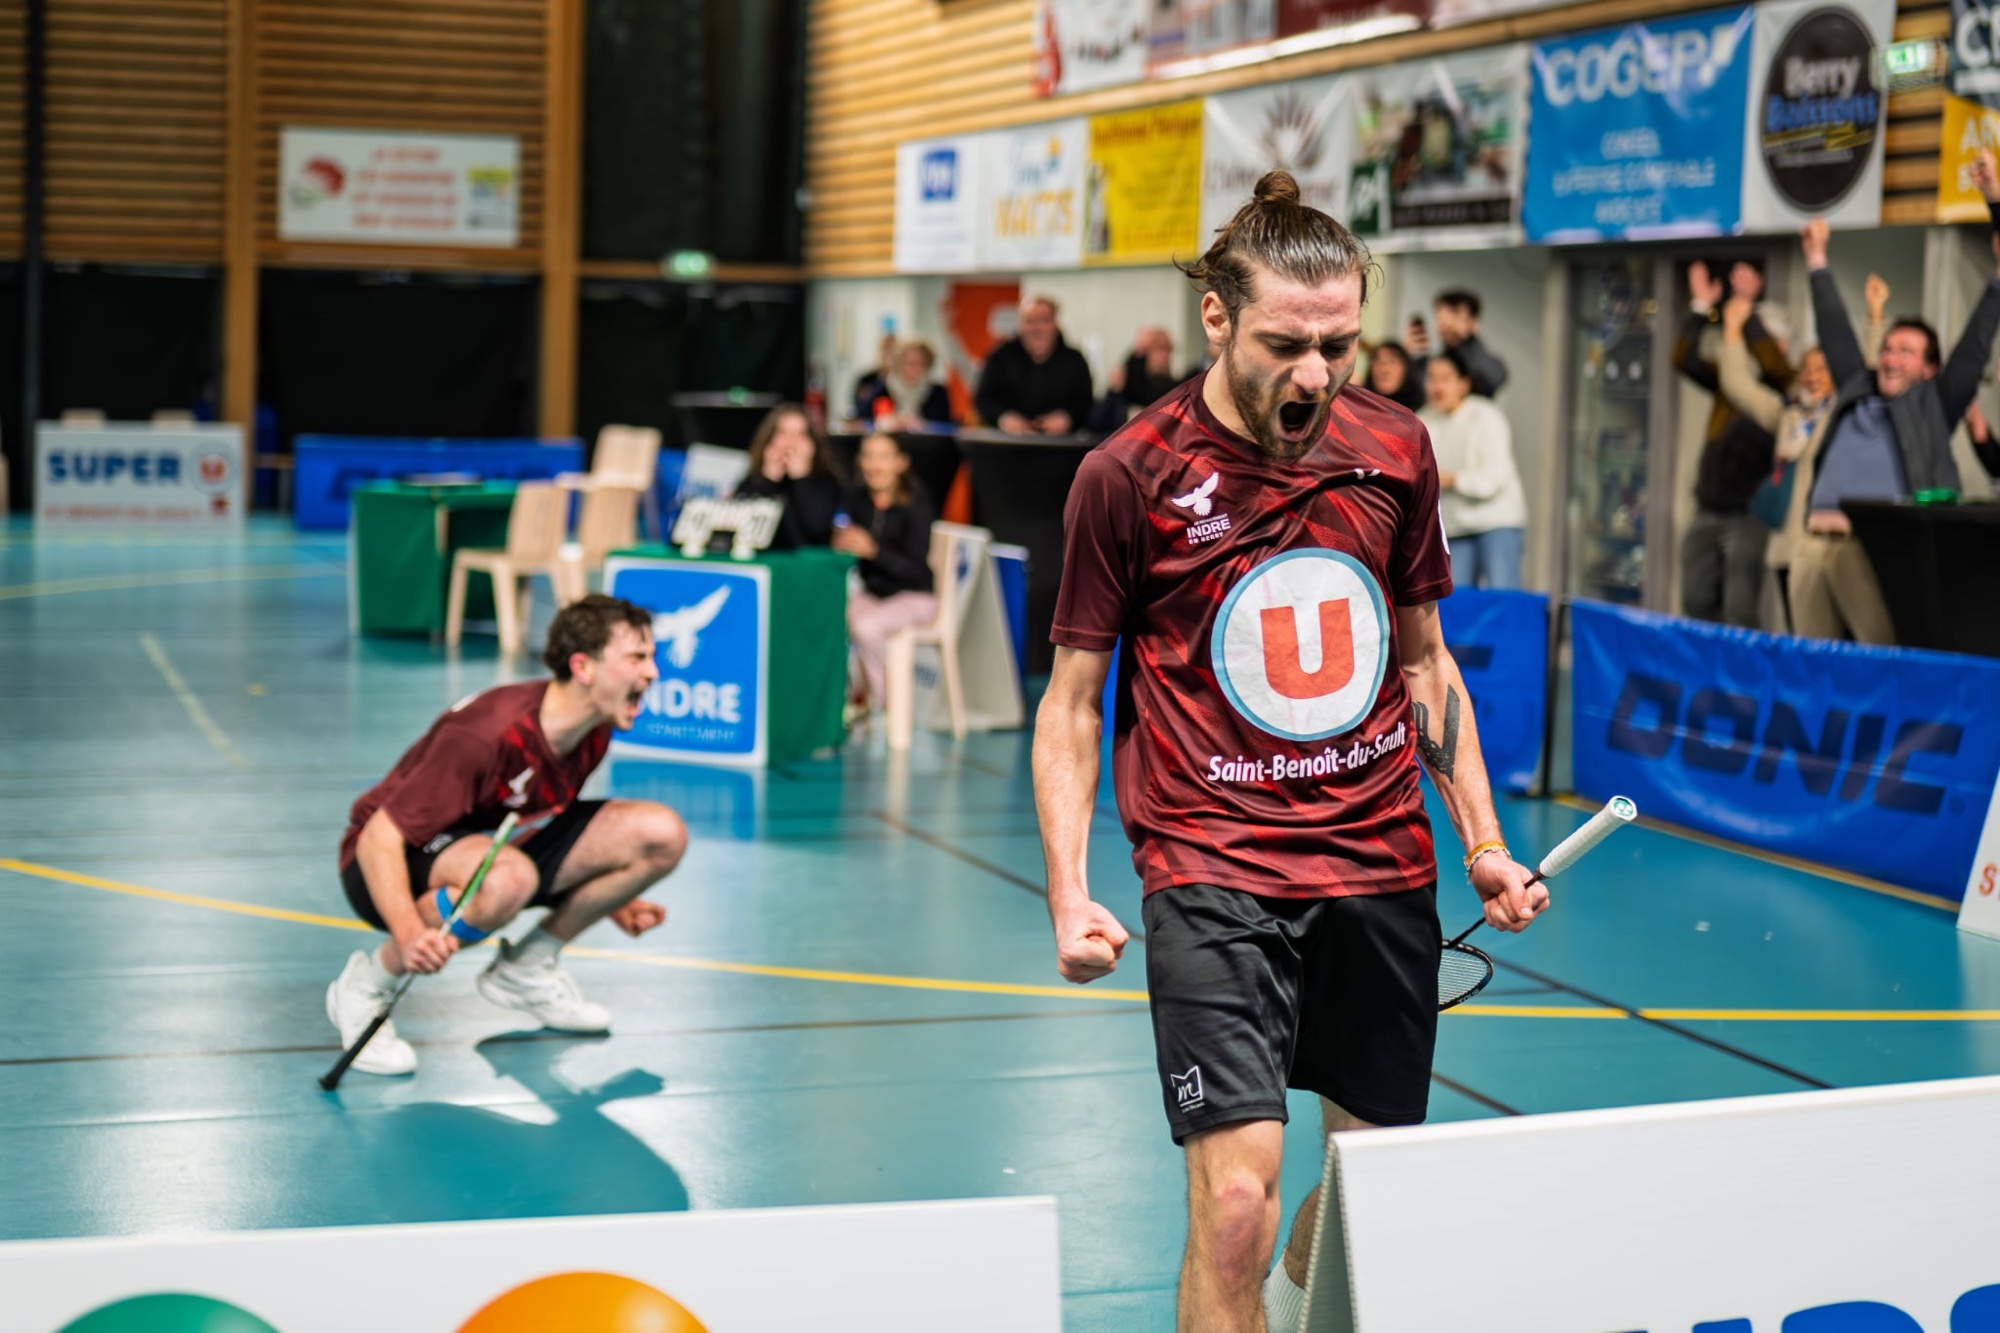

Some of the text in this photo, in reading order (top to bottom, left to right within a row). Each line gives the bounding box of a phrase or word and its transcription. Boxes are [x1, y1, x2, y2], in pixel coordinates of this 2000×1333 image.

[47, 449, 183, 487] SUPER
[1186, 518, 1231, 539] INDRE
[1259, 597, 1356, 700] U
[640, 678, 742, 724] NDRE
[1207, 720, 1407, 783] Saint-Benoît-du-Sault
[1607, 672, 1965, 818] DONIC
